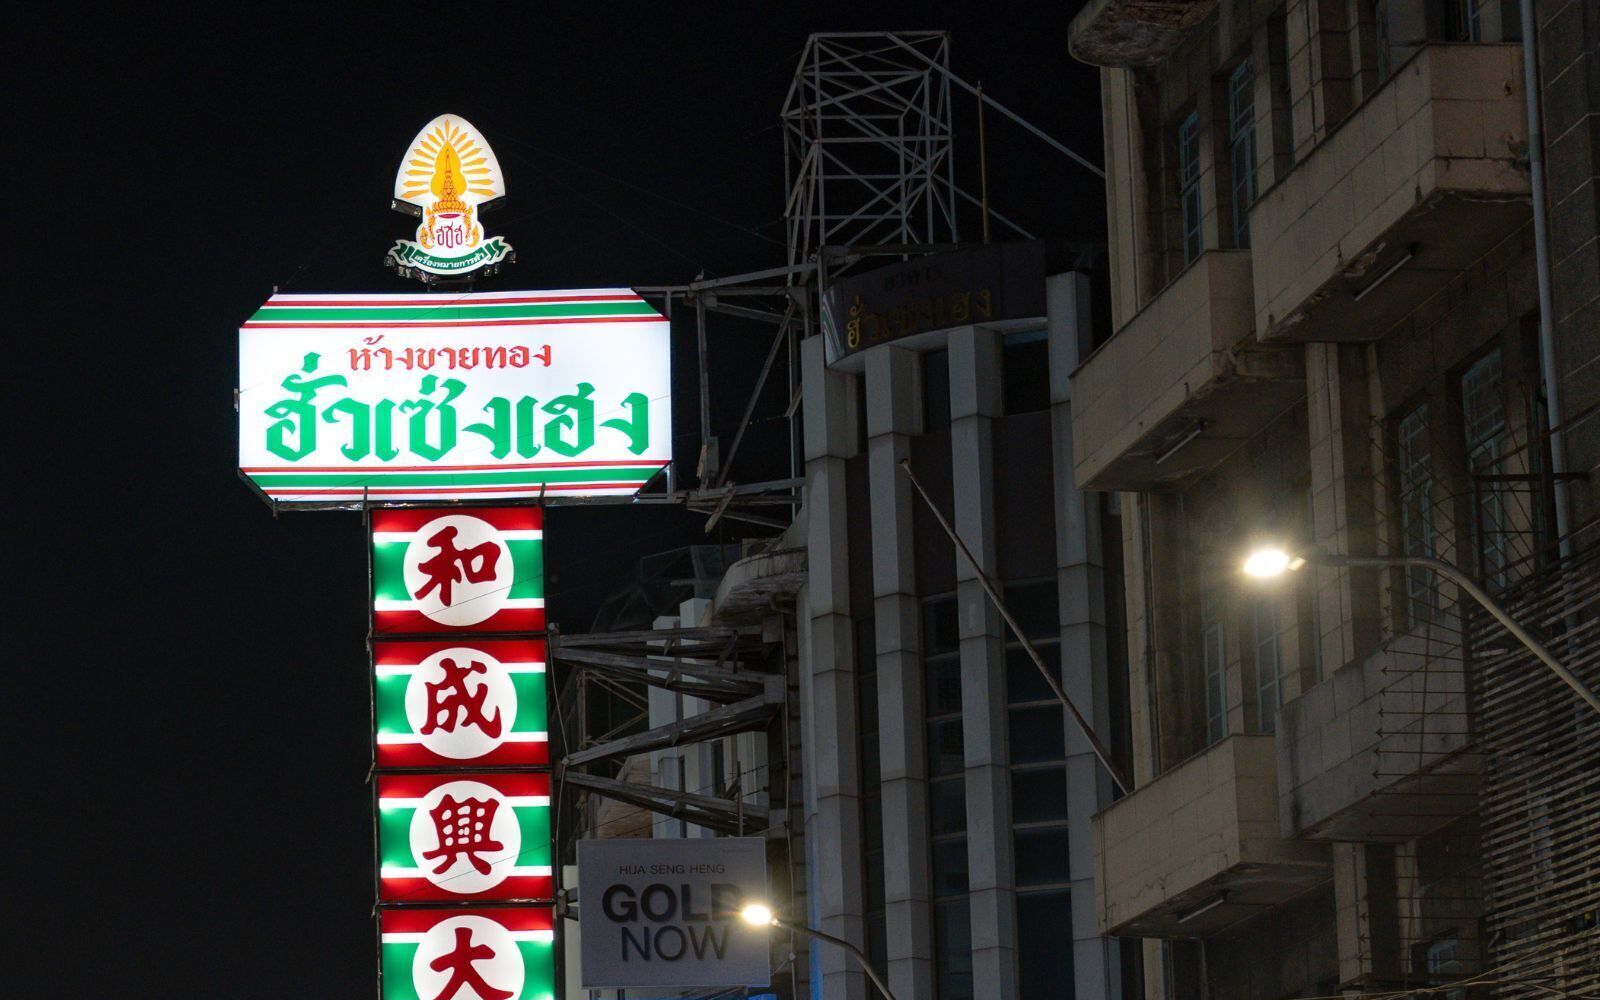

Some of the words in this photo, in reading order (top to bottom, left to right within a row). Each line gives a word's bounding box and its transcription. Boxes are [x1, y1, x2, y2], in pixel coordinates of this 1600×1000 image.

[346, 335, 552, 372] ห้างขายทอง
[263, 351, 650, 462] ฮั่วเซ่งเฮง
[619, 864, 645, 874] HUA
[650, 864, 685, 874] SENG
[689, 863, 725, 874] HENG
[621, 924, 730, 962] NOW
